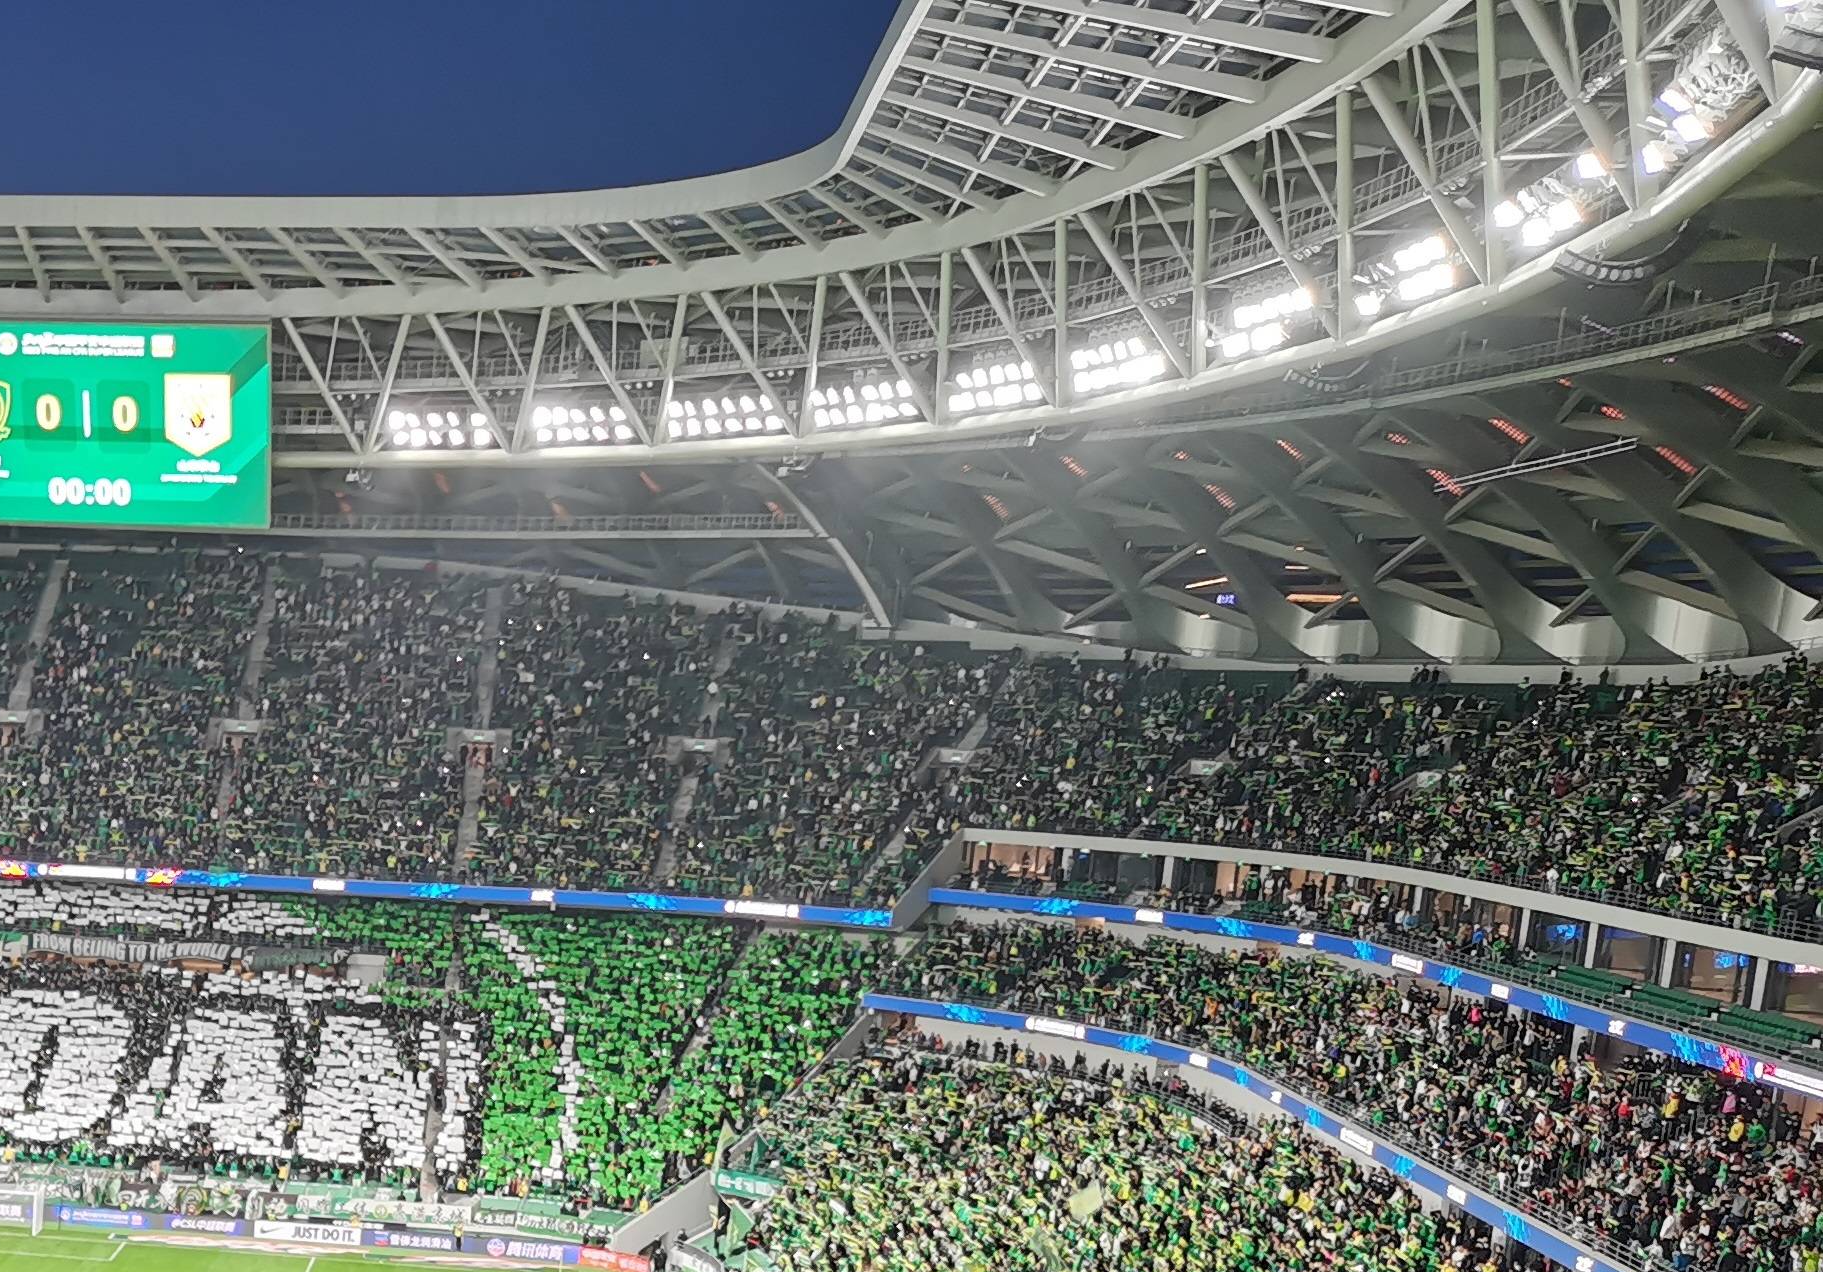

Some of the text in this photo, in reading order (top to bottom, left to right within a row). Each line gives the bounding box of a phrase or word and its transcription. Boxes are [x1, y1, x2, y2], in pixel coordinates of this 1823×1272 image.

[36, 394, 139, 432] 0 0
[47, 477, 132, 506] 00:00
[32, 932, 74, 953] FROM
[75, 936, 126, 959] BEIJING
[128, 940, 146, 962] TO
[149, 939, 175, 961] THE
[176, 941, 226, 961] WORLD
[291, 1226, 355, 1243] JUST DO IT.
[506, 1241, 563, 1261] 腾讯体育
